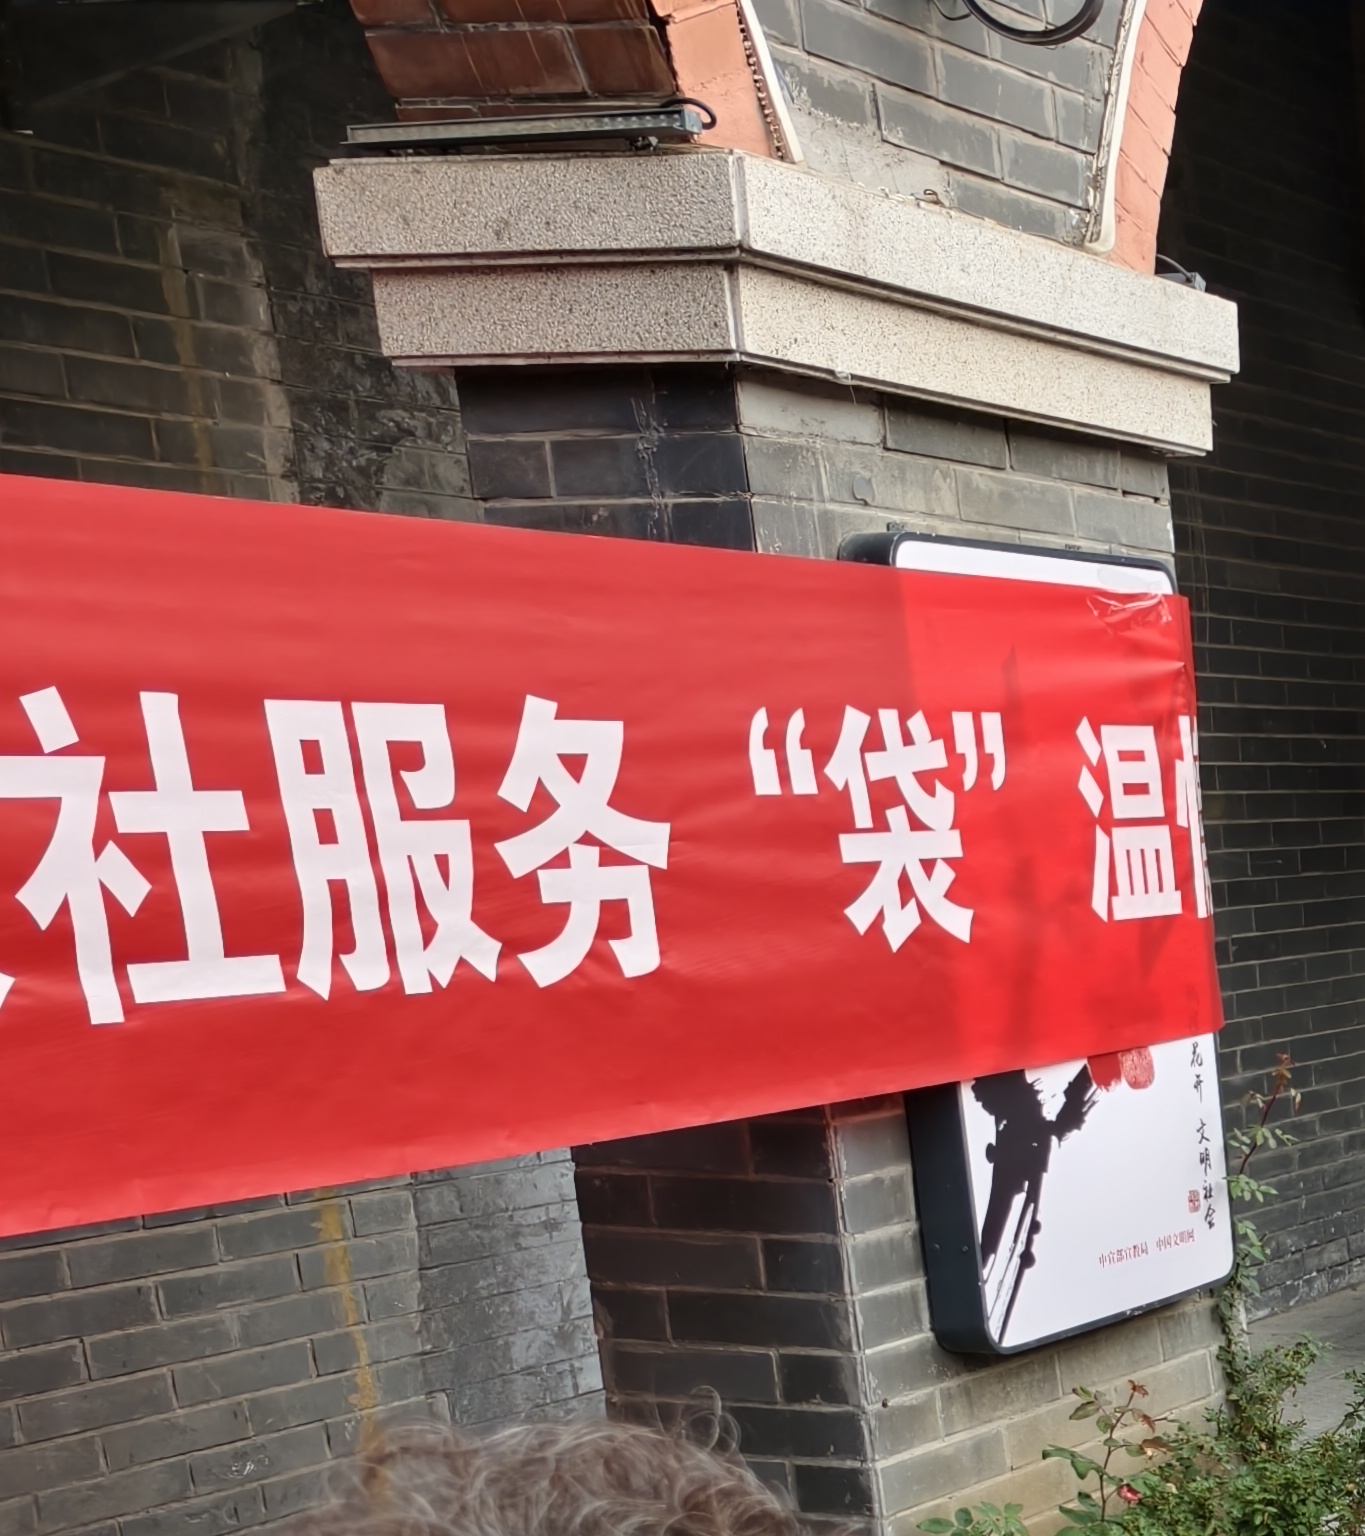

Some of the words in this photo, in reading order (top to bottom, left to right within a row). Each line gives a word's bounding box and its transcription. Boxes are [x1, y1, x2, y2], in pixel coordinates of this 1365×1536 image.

[0, 686, 1211, 1024] 社服务“袋”温
[1196, 1118, 1216, 1230] 文明社会
[1099, 1241, 1149, 1268] 中宣部宣教局
[1156, 1228, 1195, 1252] 中国文明网
